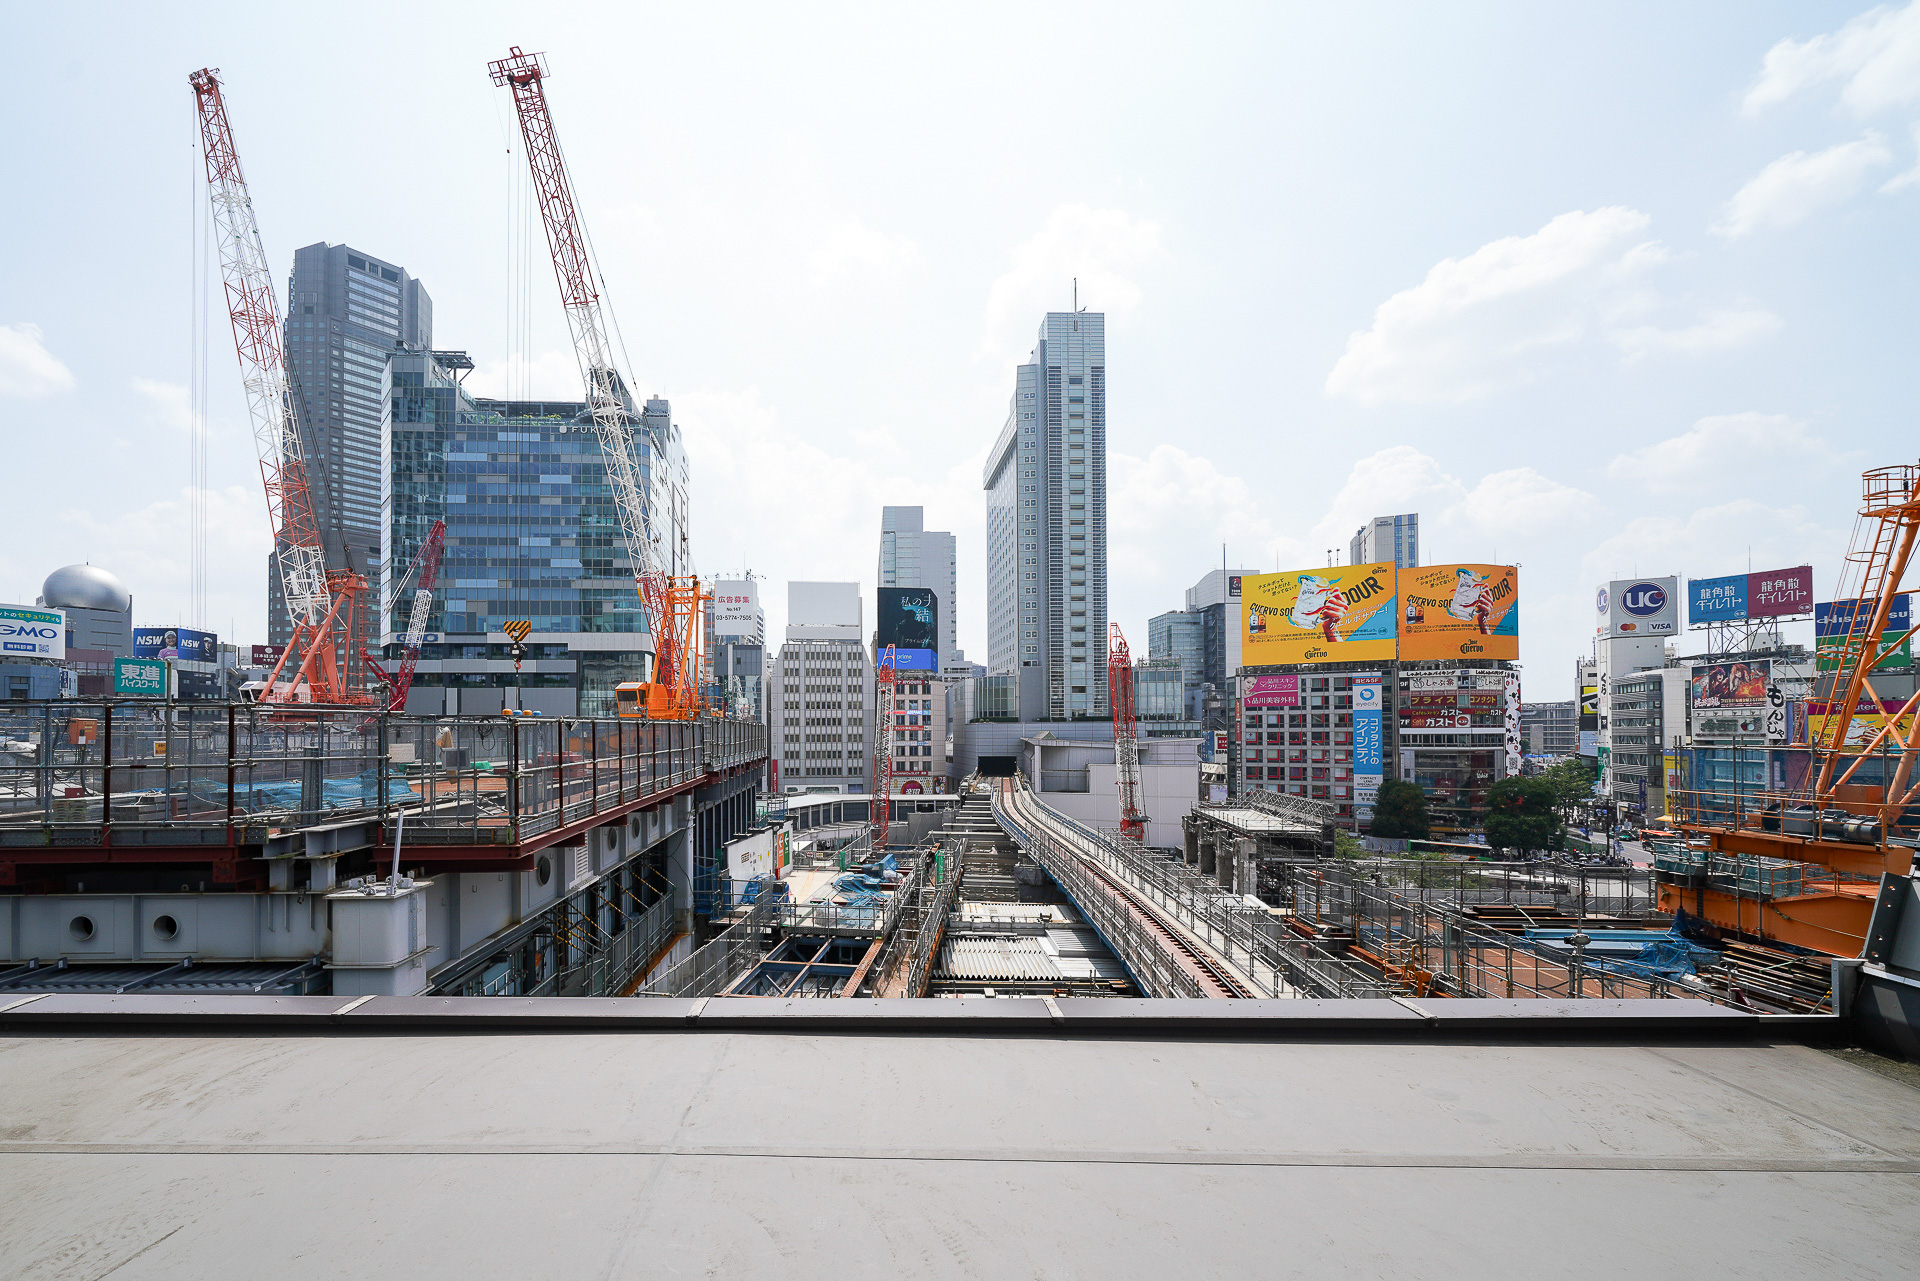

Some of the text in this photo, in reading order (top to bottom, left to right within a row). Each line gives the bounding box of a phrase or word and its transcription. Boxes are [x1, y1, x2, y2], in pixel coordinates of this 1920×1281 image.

[571, 426, 635, 435] FUKUAS
[1700, 584, 1736, 600] 龍角散
[718, 596, 750, 604] 広告募集
[1650, 622, 1672, 630] VISA
[0, 624, 58, 639] GMO
[136, 635, 163, 645] NSW
[396, 633, 439, 642] GO
[180, 638, 200, 649] NSW
[1459, 642, 1485, 655] Cuervo
[896, 653, 913, 661] prime
[1304, 650, 1328, 660] Cuervo
[121, 664, 160, 681] 東進
[120, 679, 160, 689] ハイスクール
[1251, 696, 1296, 705] 品川美容外科
[1470, 696, 1497, 704] コンタクト
[1440, 708, 1463, 716] ガスト
[1766, 684, 1785, 739] もんじゃ
[1425, 717, 1454, 727] ガスト
[1356, 718, 1369, 765] アイシティ
[1370, 718, 1380, 765] コンタクトの
